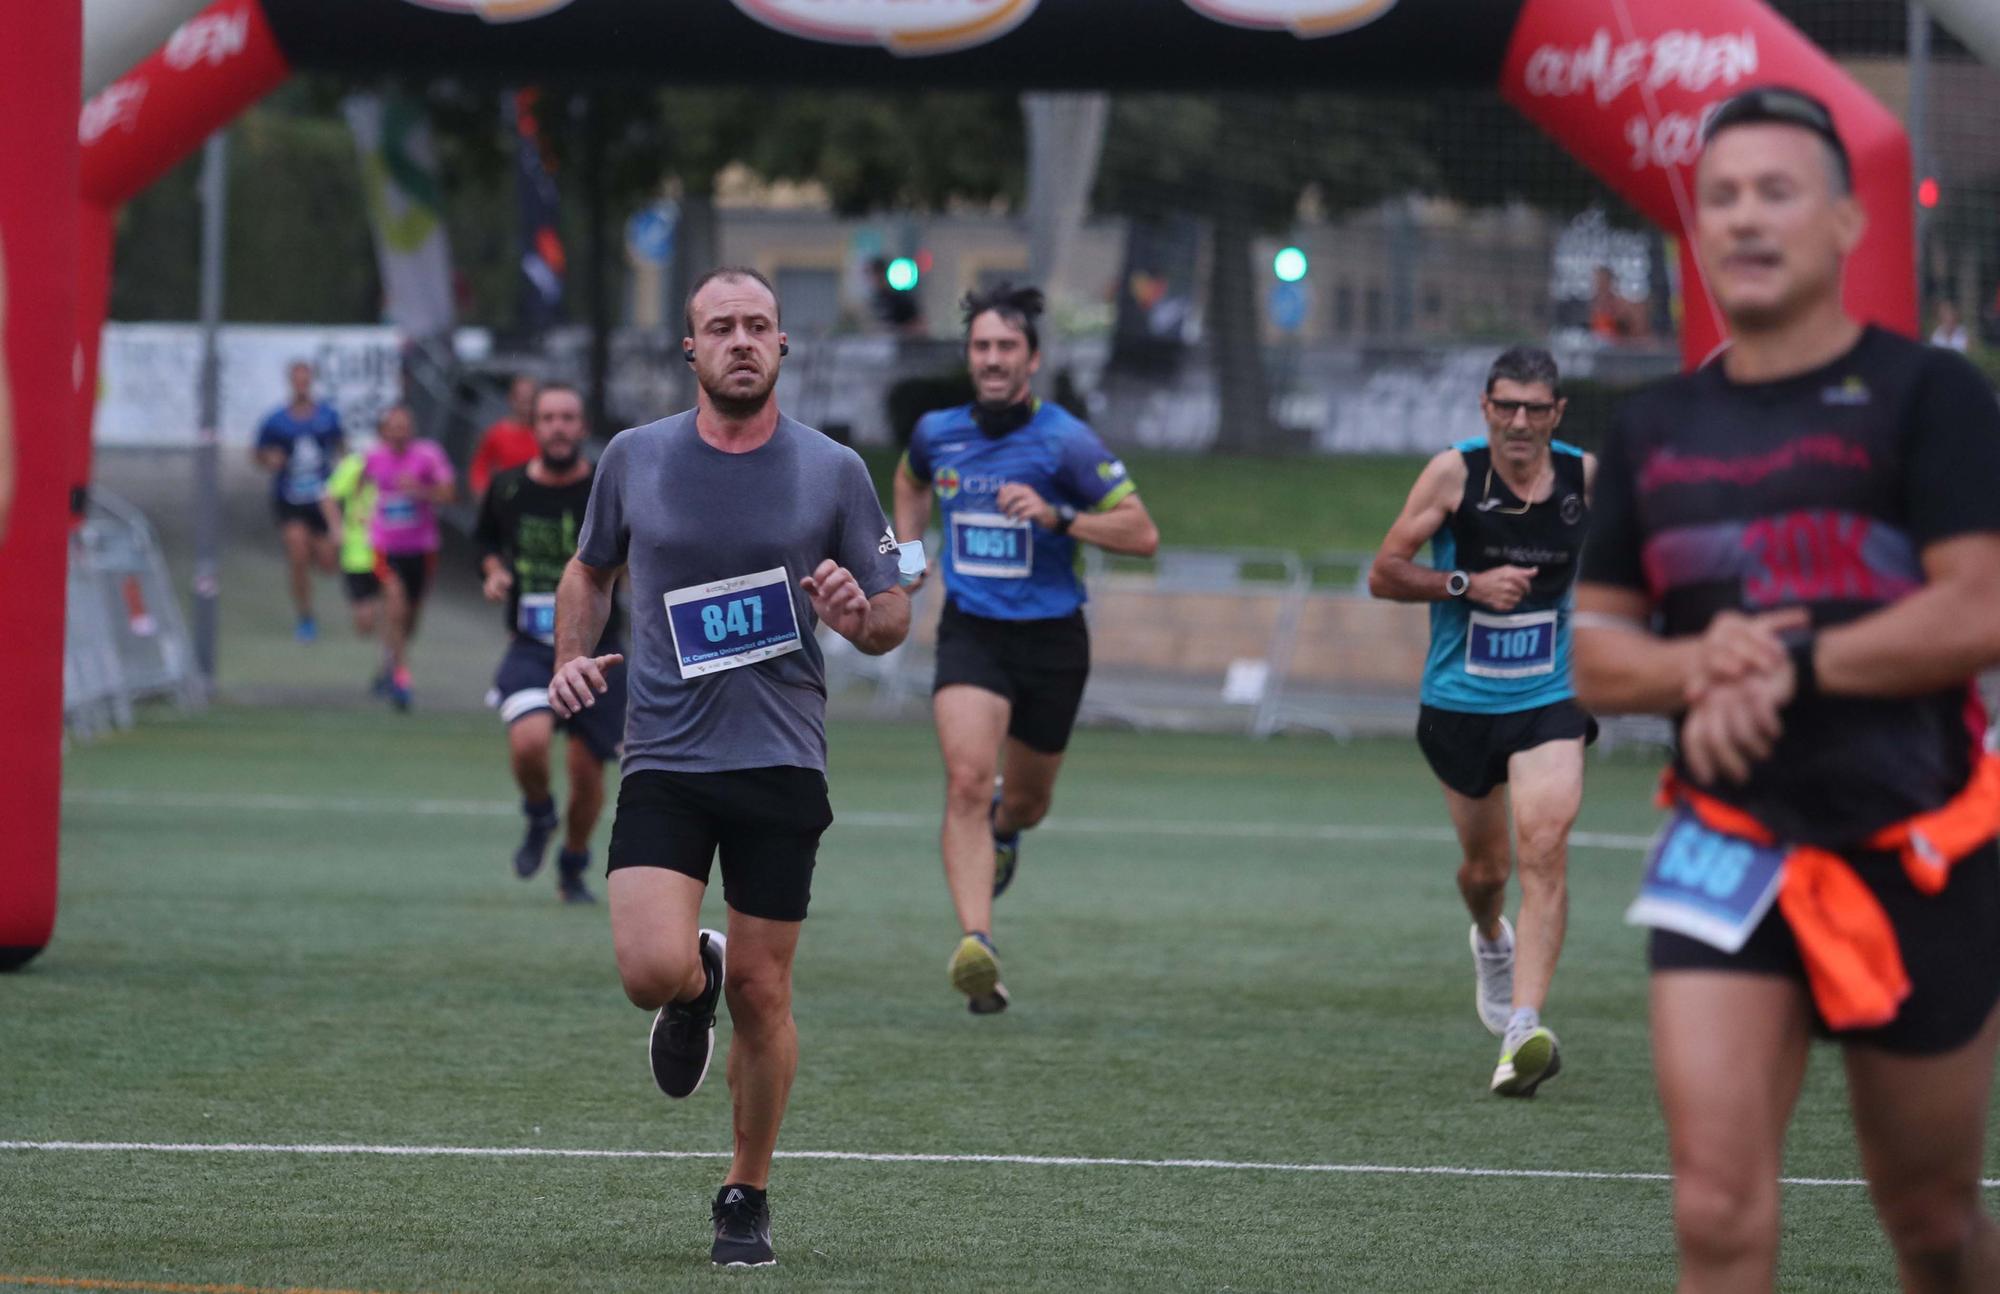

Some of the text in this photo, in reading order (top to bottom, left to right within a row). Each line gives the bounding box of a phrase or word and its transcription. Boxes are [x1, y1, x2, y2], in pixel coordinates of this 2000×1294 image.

[964, 527, 1017, 558] 1051
[701, 595, 763, 643] 847
[692, 651, 719, 662] Carrera
[719, 643, 756, 656] Universitat
[1486, 628, 1542, 658] 1107
